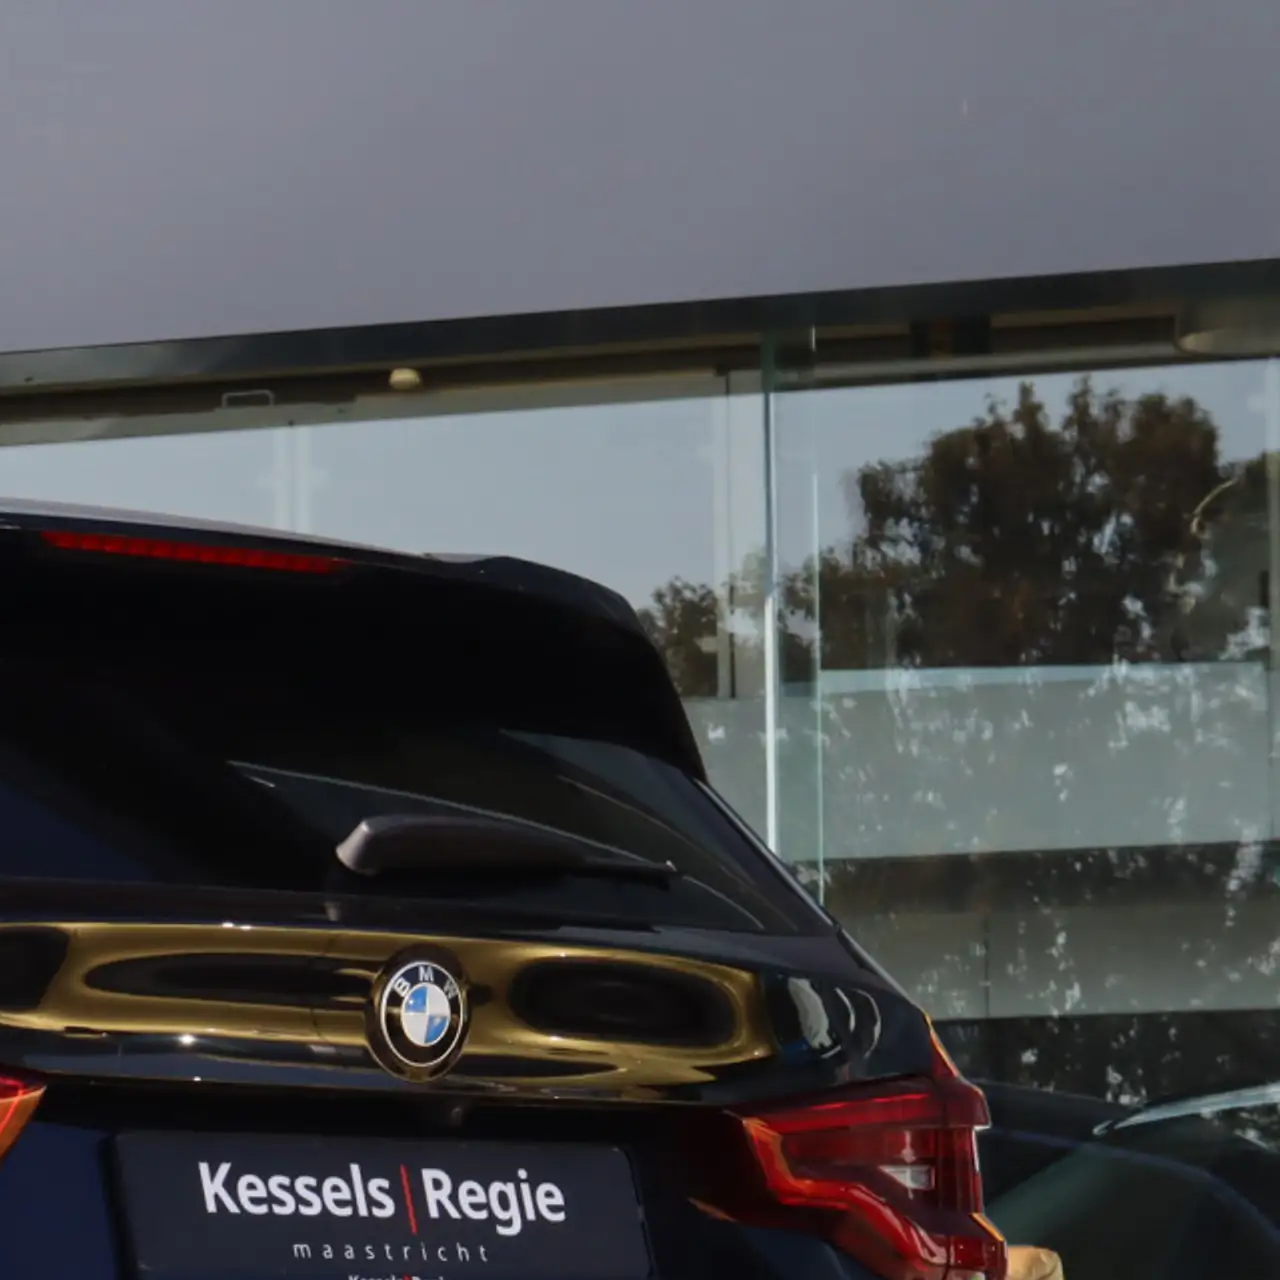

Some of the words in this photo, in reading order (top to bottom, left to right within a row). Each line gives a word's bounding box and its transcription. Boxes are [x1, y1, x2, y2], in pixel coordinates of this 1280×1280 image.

[197, 1161, 396, 1219] Kessels
[422, 1168, 566, 1237] Regie
[292, 1241, 489, 1263] maastricht
